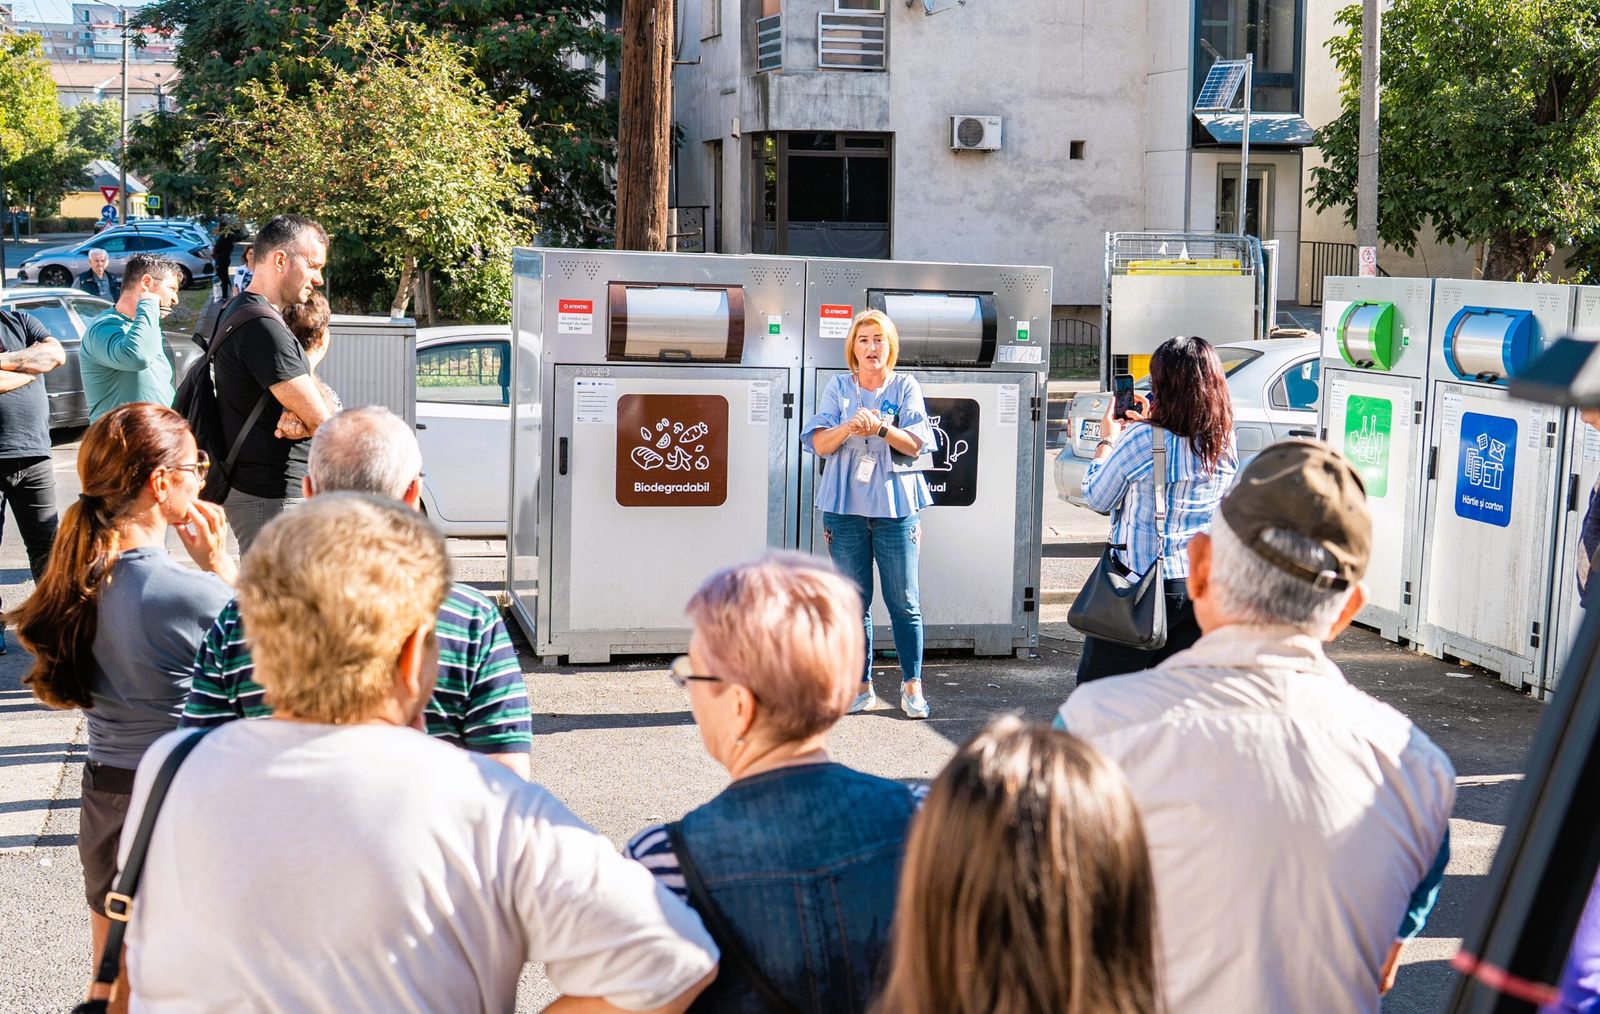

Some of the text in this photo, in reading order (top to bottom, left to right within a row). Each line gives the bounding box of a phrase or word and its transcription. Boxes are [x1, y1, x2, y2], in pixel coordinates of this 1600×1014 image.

[634, 482, 710, 494] Biodegradabil
[1462, 494, 1503, 512] Hârtie și carton
